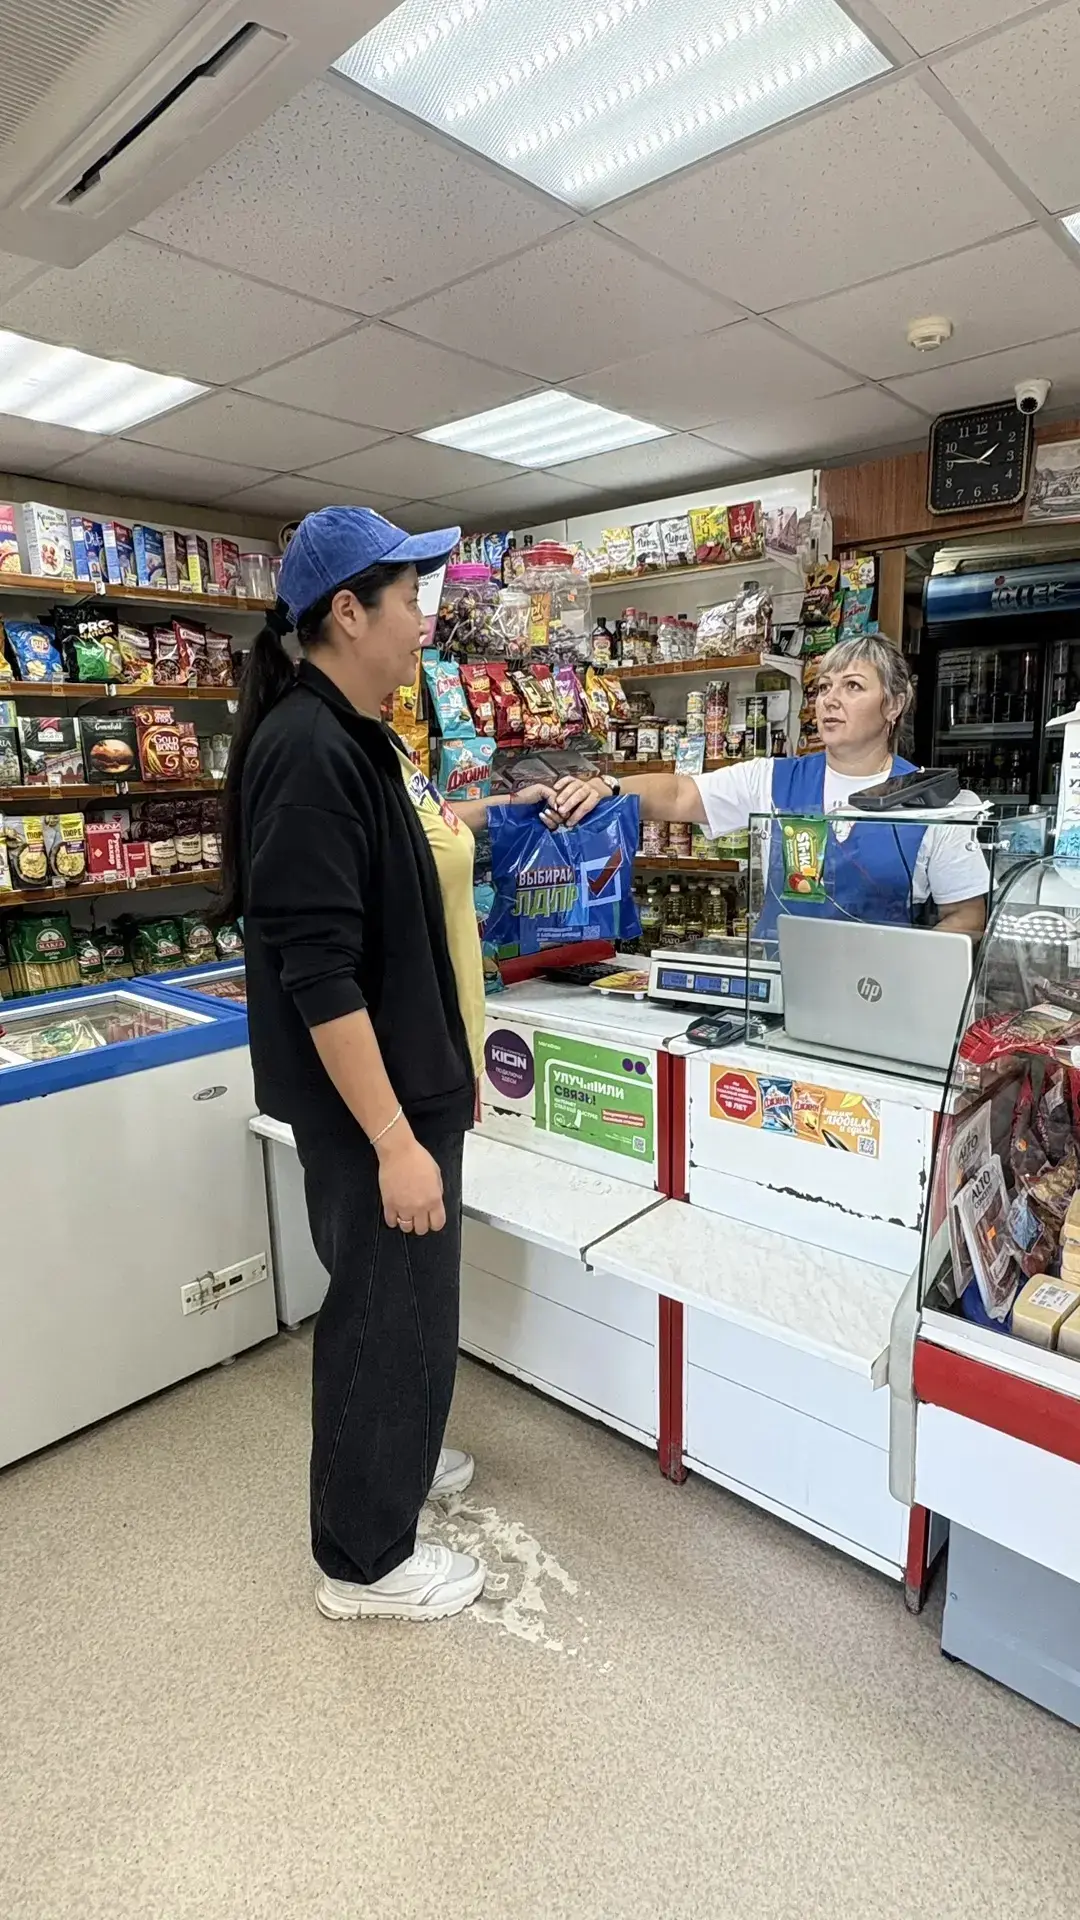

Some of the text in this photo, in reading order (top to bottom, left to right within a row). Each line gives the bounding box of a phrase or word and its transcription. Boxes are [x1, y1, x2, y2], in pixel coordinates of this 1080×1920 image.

[976, 424, 988, 435] 12
[997, 421, 1003, 431] 1
[959, 427, 969, 438] 11
[1008, 431, 1016, 442] 2
[946, 442, 957, 453] 10
[1007, 450, 1015, 461] 3
[946, 461, 954, 471] 9
[1005, 469, 1013, 478] 4
[945, 478, 952, 488] 8
[956, 489, 964, 499] 7
[974, 486, 981, 497] 6
[991, 484, 999, 494] 5
[154, 735, 179, 745] GOLD
[447, 765, 491, 792] ДЖИНН
[512, 884, 580, 919] ЛДПР
[861, 979, 880, 998] hp
[492, 1049, 527, 1070] KION
[554, 1085, 596, 1106] СВЯЗЬ!
[733, 1102, 748, 1112] ЛЕТ
[958, 1134, 979, 1164] ALTO
[971, 1170, 991, 1204] ALTO
